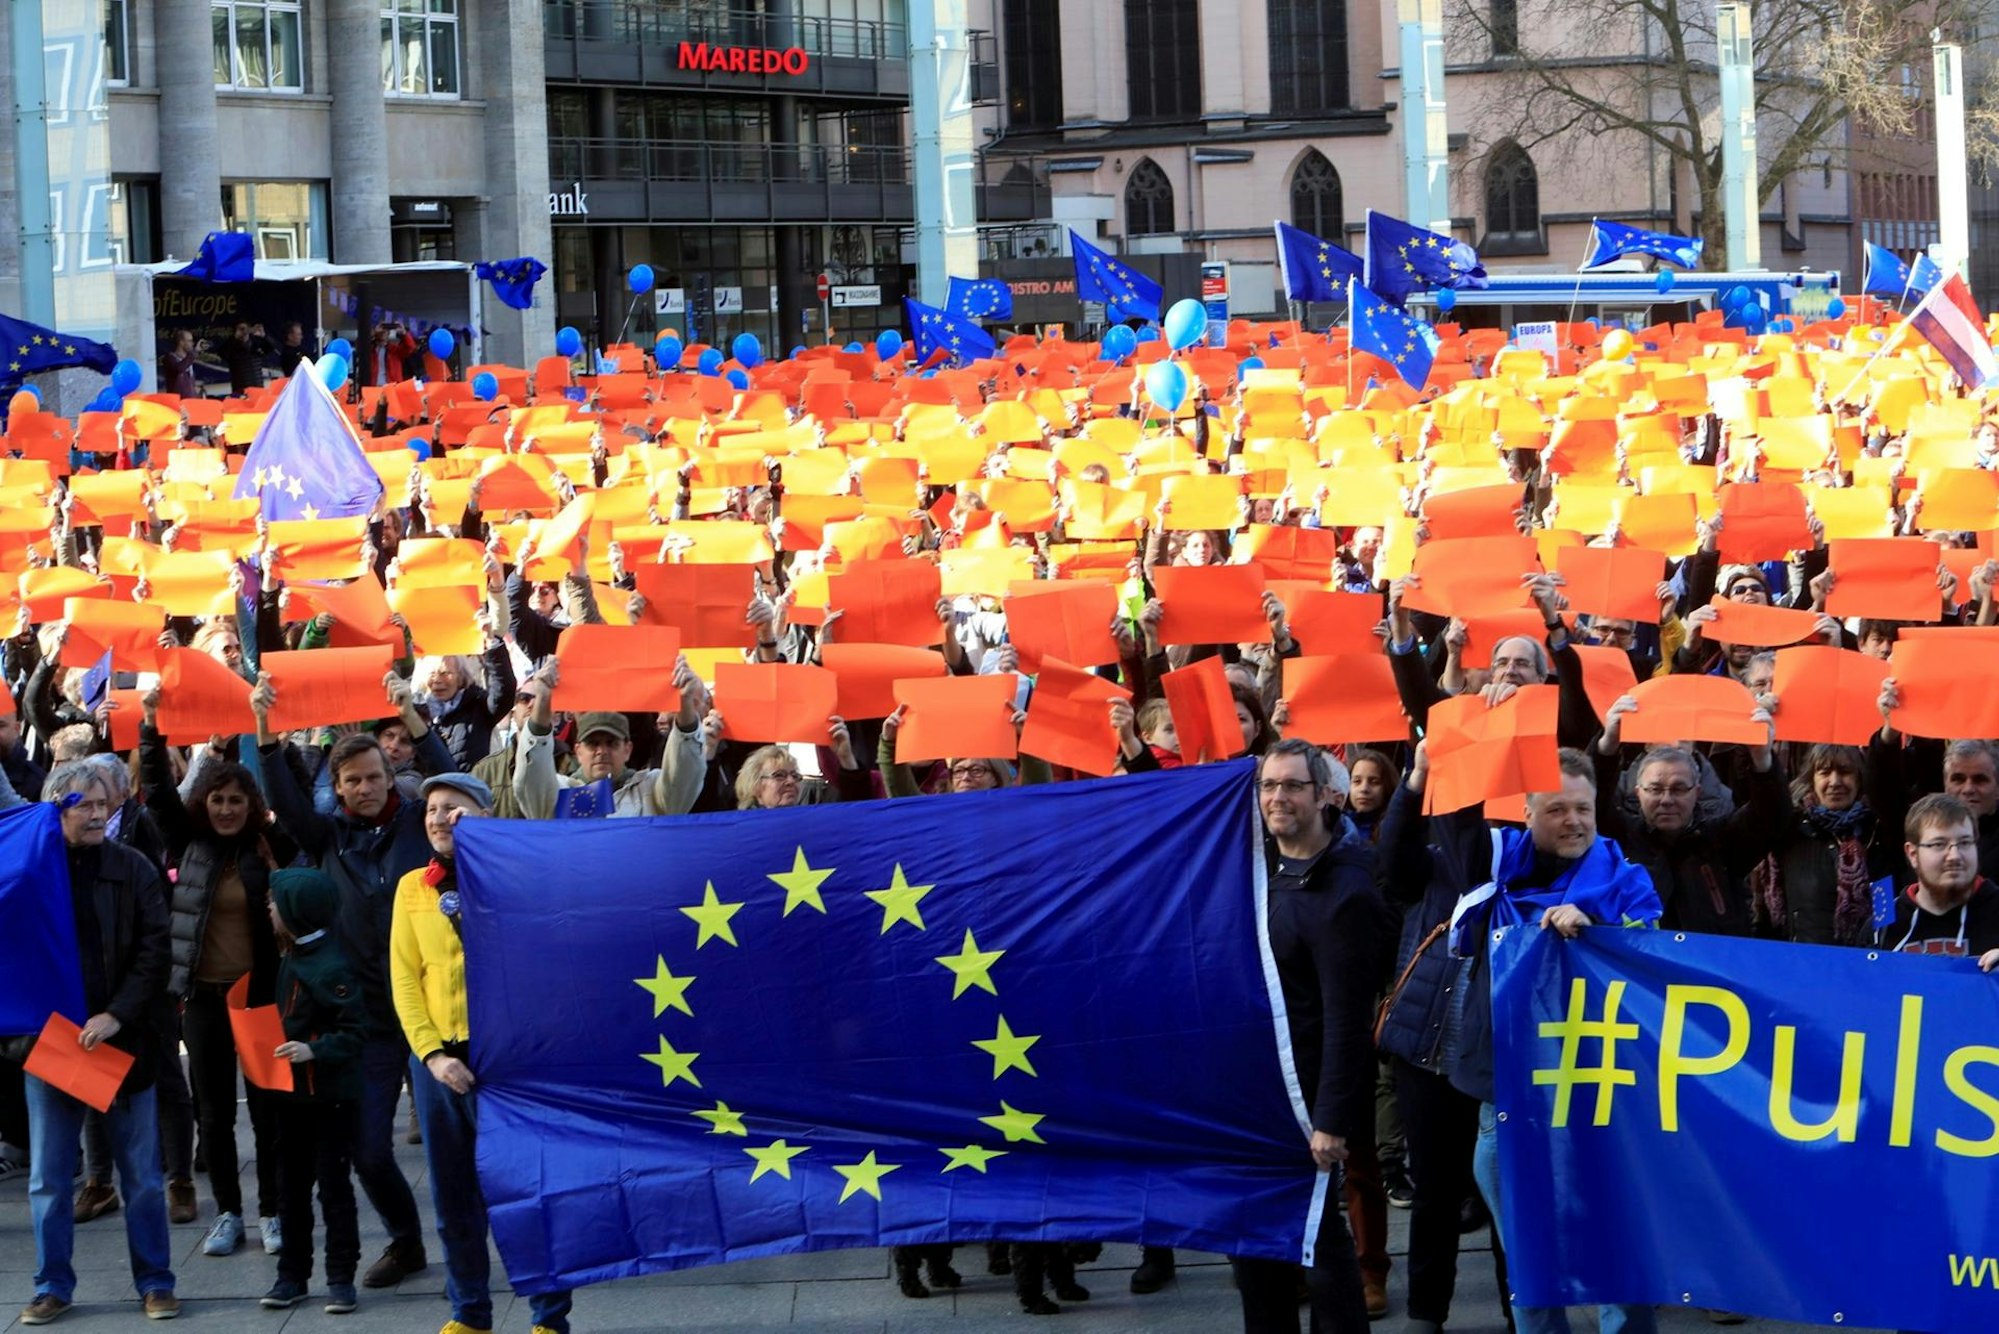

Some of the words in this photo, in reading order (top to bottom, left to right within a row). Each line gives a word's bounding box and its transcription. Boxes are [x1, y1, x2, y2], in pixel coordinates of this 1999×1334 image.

[1520, 324, 1553, 336] EUROPA
[1532, 977, 1999, 1158] #Puls
[1948, 1254, 1999, 1290] w
